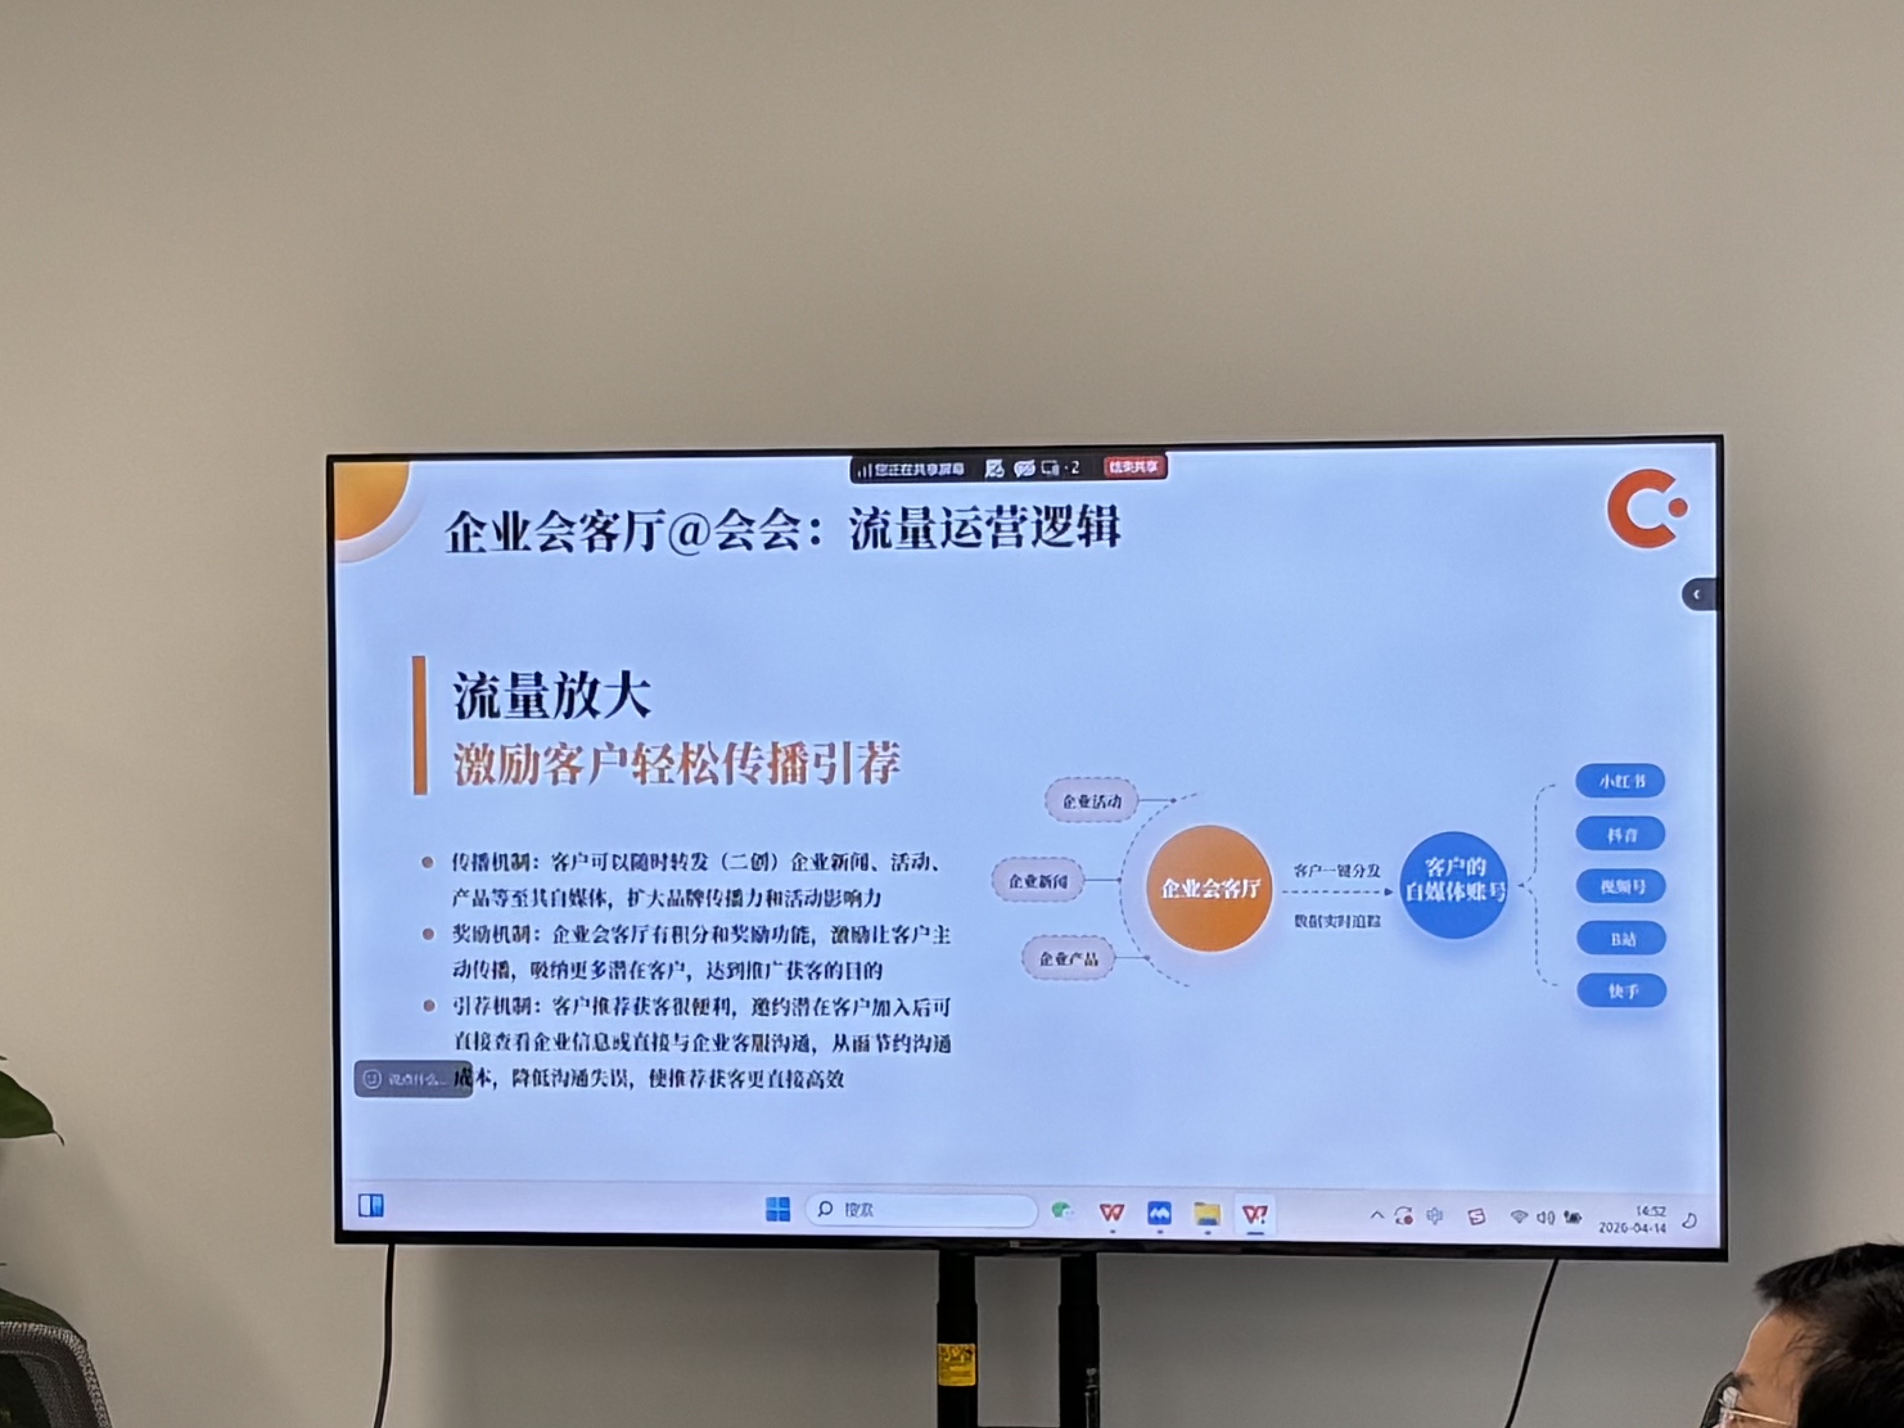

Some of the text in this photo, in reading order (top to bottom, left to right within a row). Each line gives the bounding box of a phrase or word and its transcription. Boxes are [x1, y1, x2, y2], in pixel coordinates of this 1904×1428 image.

[444, 503, 1123, 557] 企业会客厅@会会：流量运营逻辑
[452, 669, 652, 721] 流量放大
[453, 740, 902, 788] 激励客户轻松传播引荐
[1062, 793, 1123, 812] 企业活动
[1424, 856, 1487, 878] 客户的
[1008, 873, 1069, 890] 企业新闻
[1159, 876, 1262, 901] 企业会客厅
[1405, 881, 1508, 904] 自媒体账号
[1038, 951, 1099, 969] 企业产品
